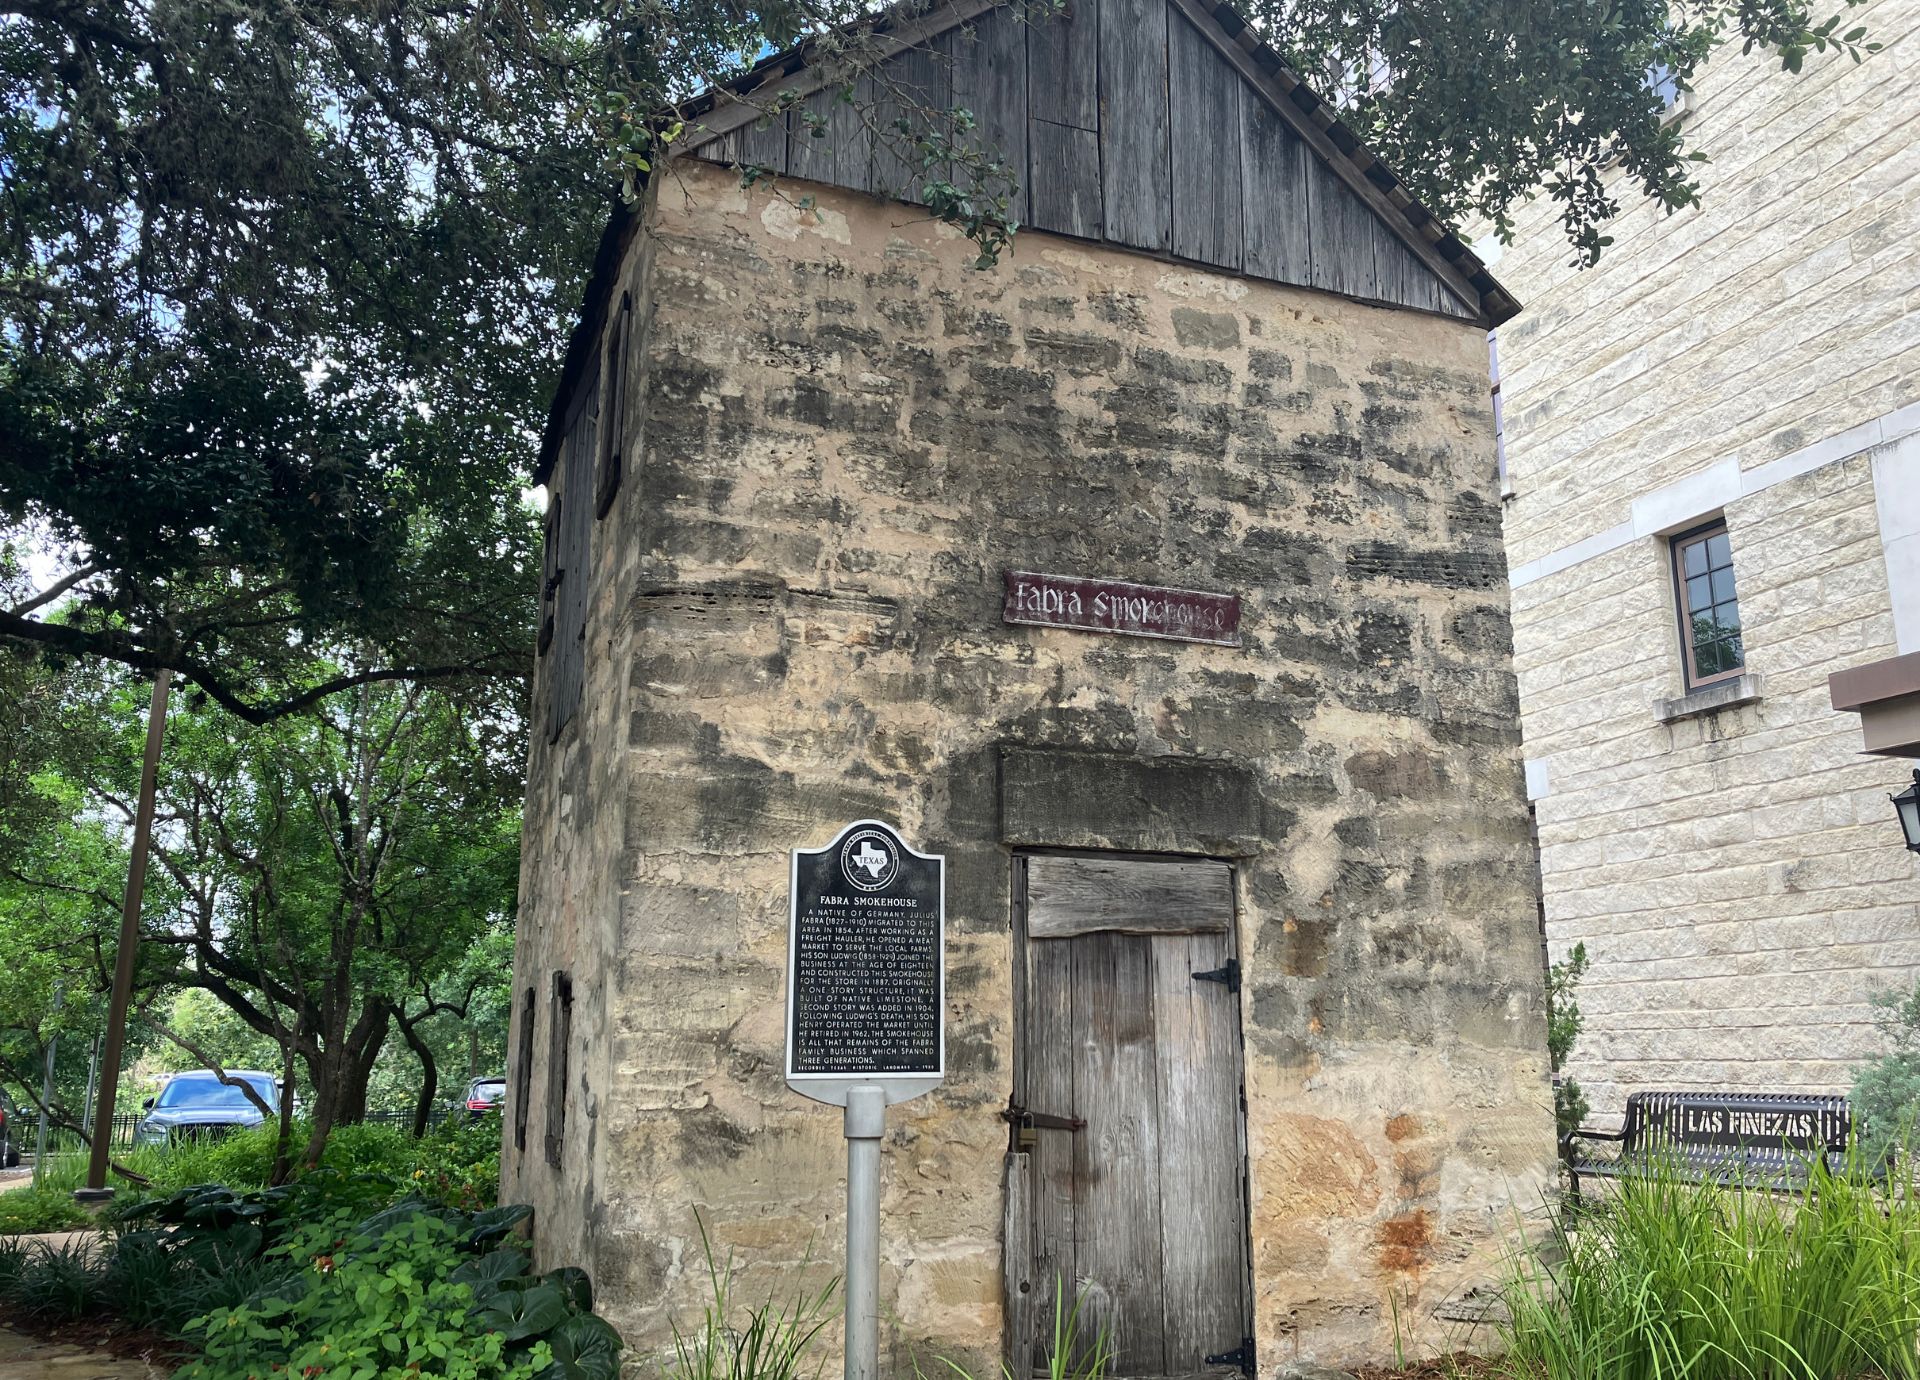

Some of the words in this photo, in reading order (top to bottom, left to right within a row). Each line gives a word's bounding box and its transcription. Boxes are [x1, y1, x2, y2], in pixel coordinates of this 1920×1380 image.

[1014, 581, 1083, 615] Fabra
[858, 856, 884, 864] TEXAS
[820, 896, 849, 906] FABRA
[854, 896, 917, 907] SMOKEHOUSE
[860, 987, 904, 995] STRUCTURE,
[1688, 1110, 1722, 1133] LAS
[1729, 1111, 1812, 1138] FINEZAS
